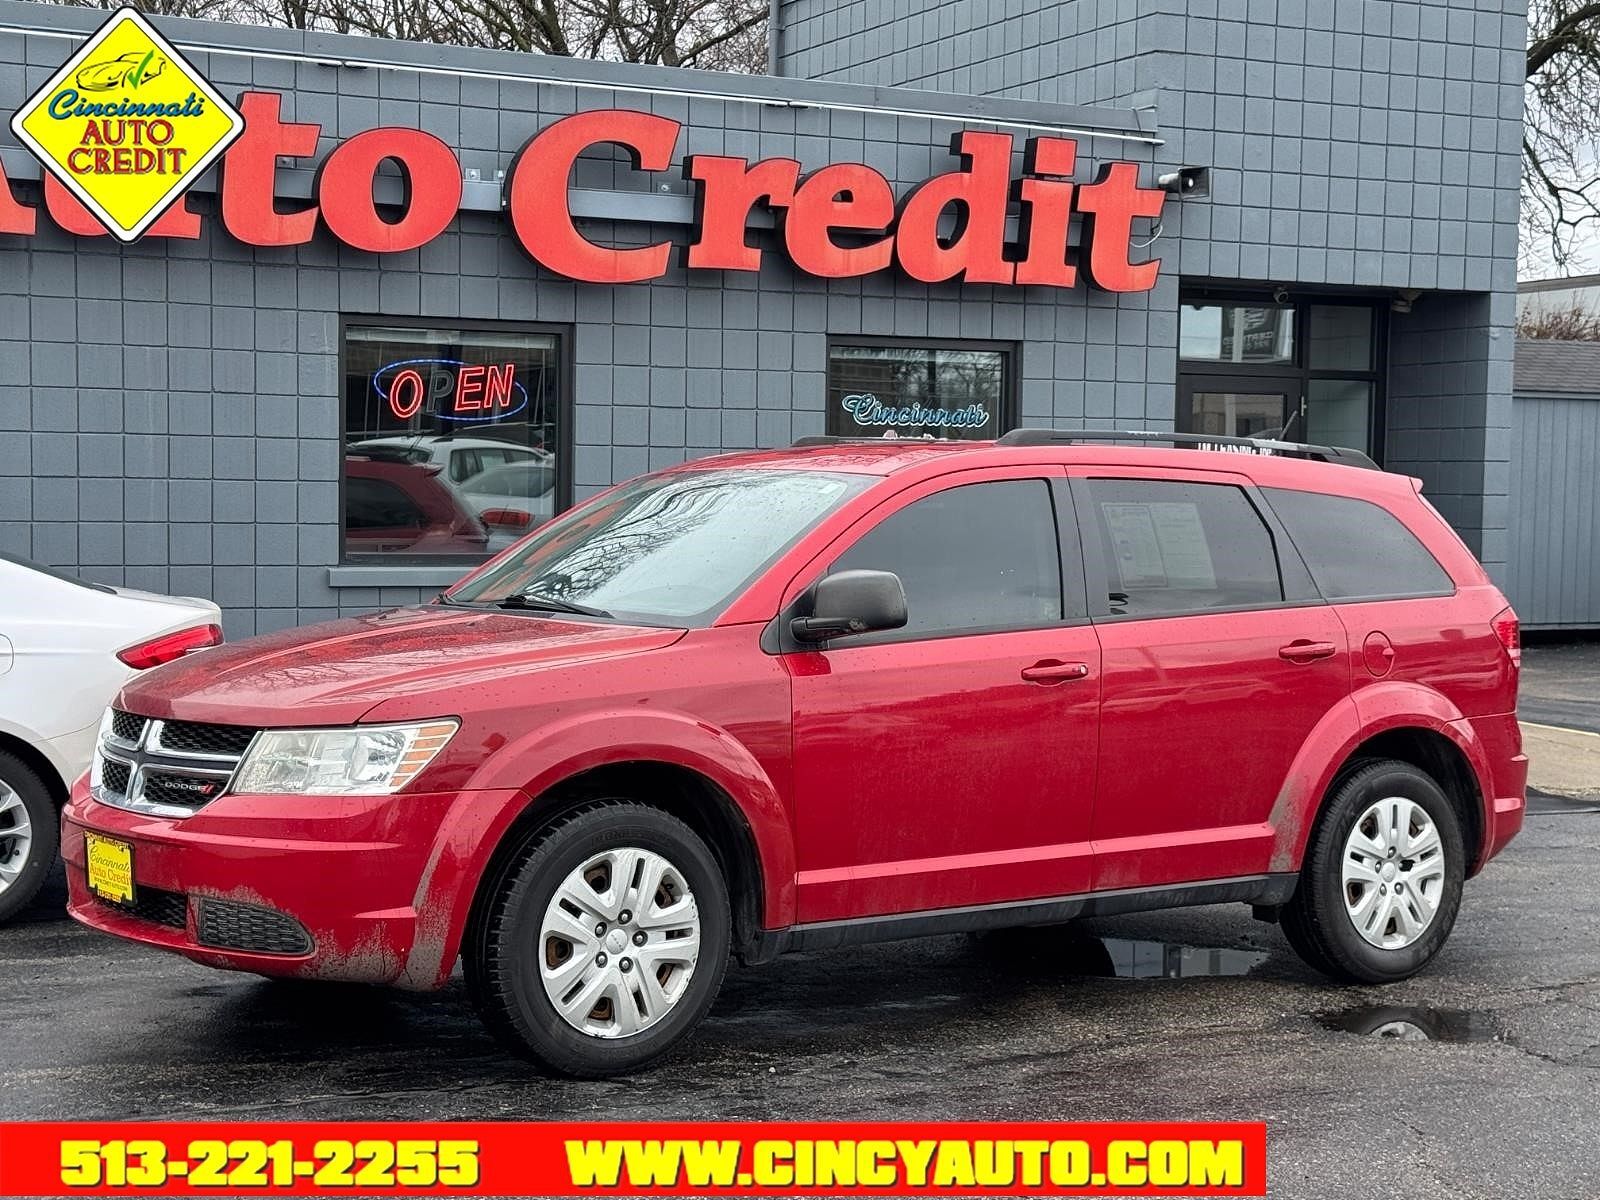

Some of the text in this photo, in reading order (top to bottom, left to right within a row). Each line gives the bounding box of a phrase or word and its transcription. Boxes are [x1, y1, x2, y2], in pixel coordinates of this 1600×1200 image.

[0, 91, 1166, 293] to Credit
[389, 363, 515, 419] OPEN
[842, 393, 989, 428] Cincinnati
[164, 781, 206, 793] DODGE
